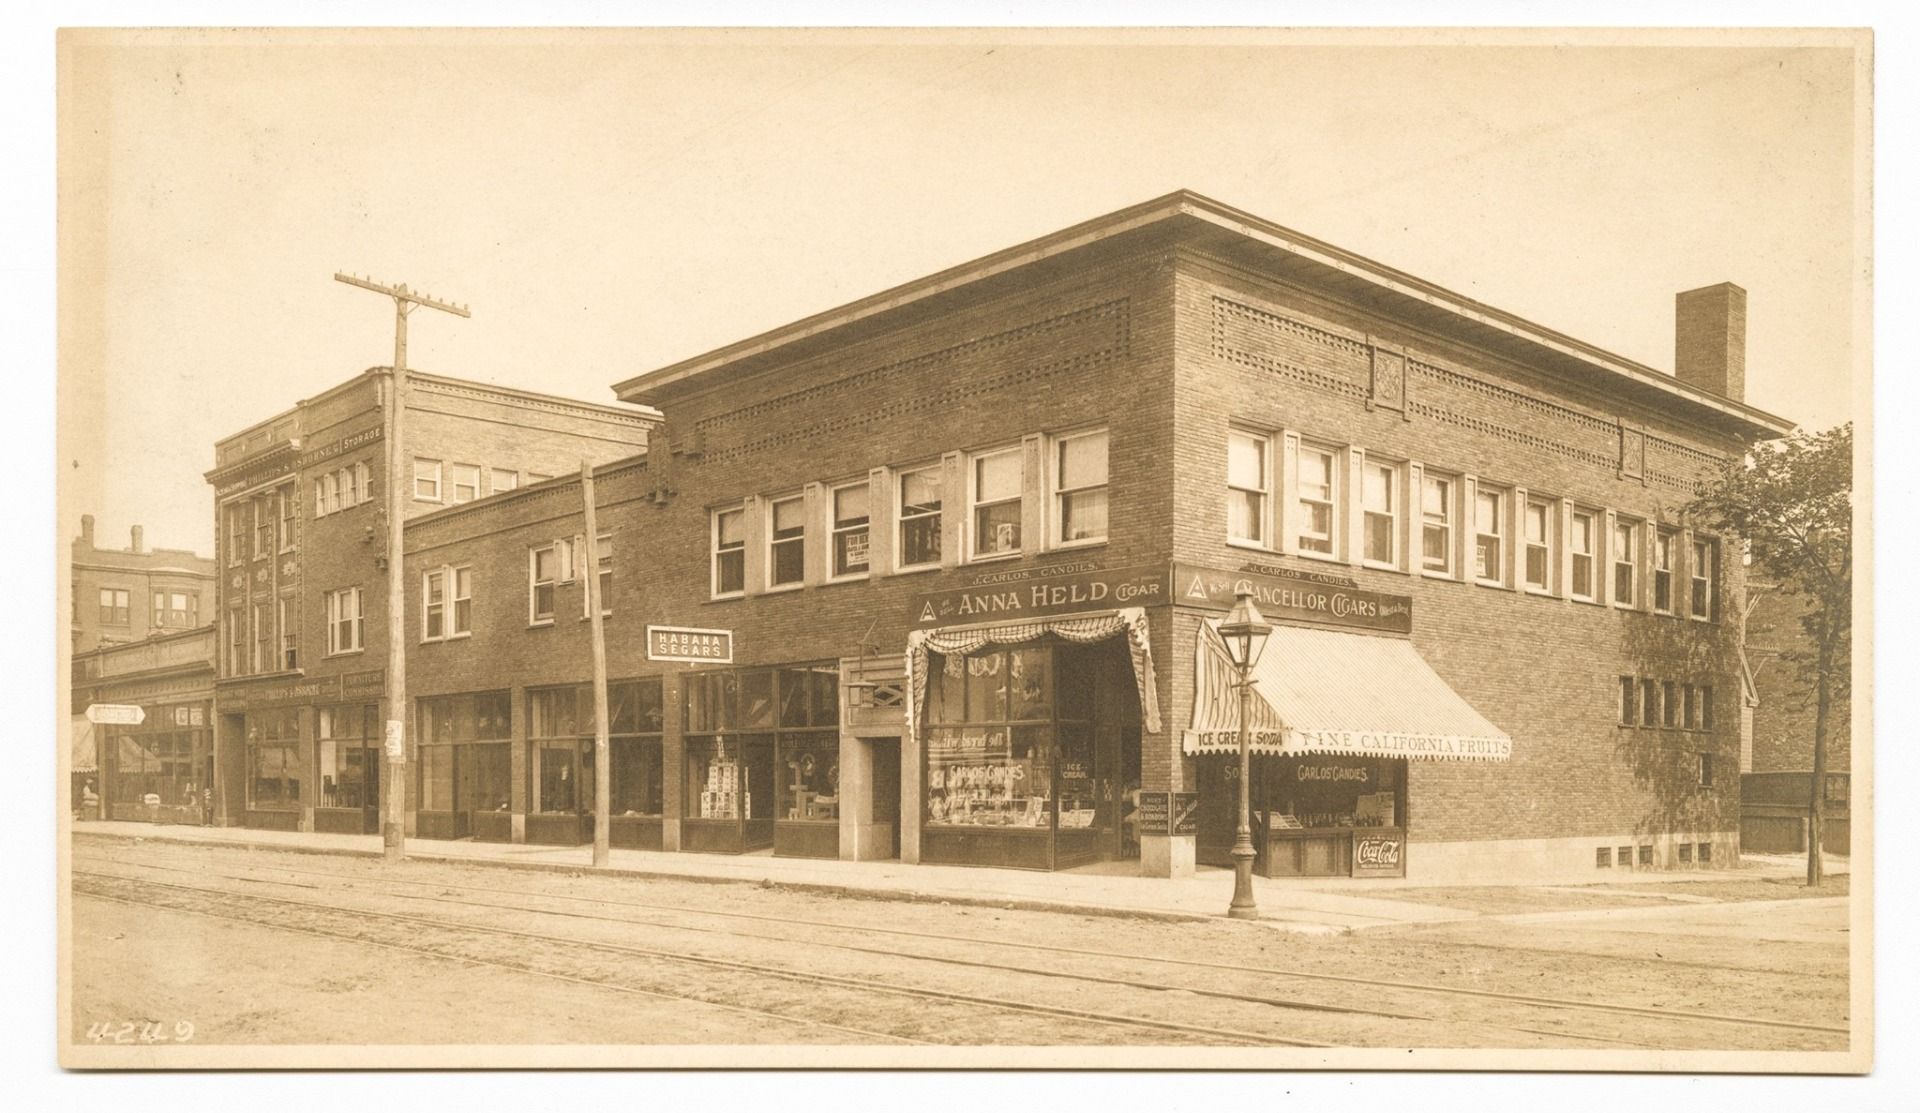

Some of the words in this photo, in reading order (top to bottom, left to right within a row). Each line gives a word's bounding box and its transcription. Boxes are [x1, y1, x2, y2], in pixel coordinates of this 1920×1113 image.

[344, 427, 381, 449] STORAGE
[958, 592, 1022, 615] ANNA
[1031, 582, 1109, 607] HELD
[1115, 583, 1160, 602] CIGAR
[1331, 592, 1376, 618] CIGARS
[659, 632, 721, 647] HABANA
[659, 643, 721, 657] SEGARS
[1198, 732, 1214, 746] ICE
[1256, 731, 1283, 746] SODA
[1302, 732, 1352, 747] FINE
[1361, 734, 1454, 753] CALIFORNIA
[1459, 738, 1511, 755] FRUITS
